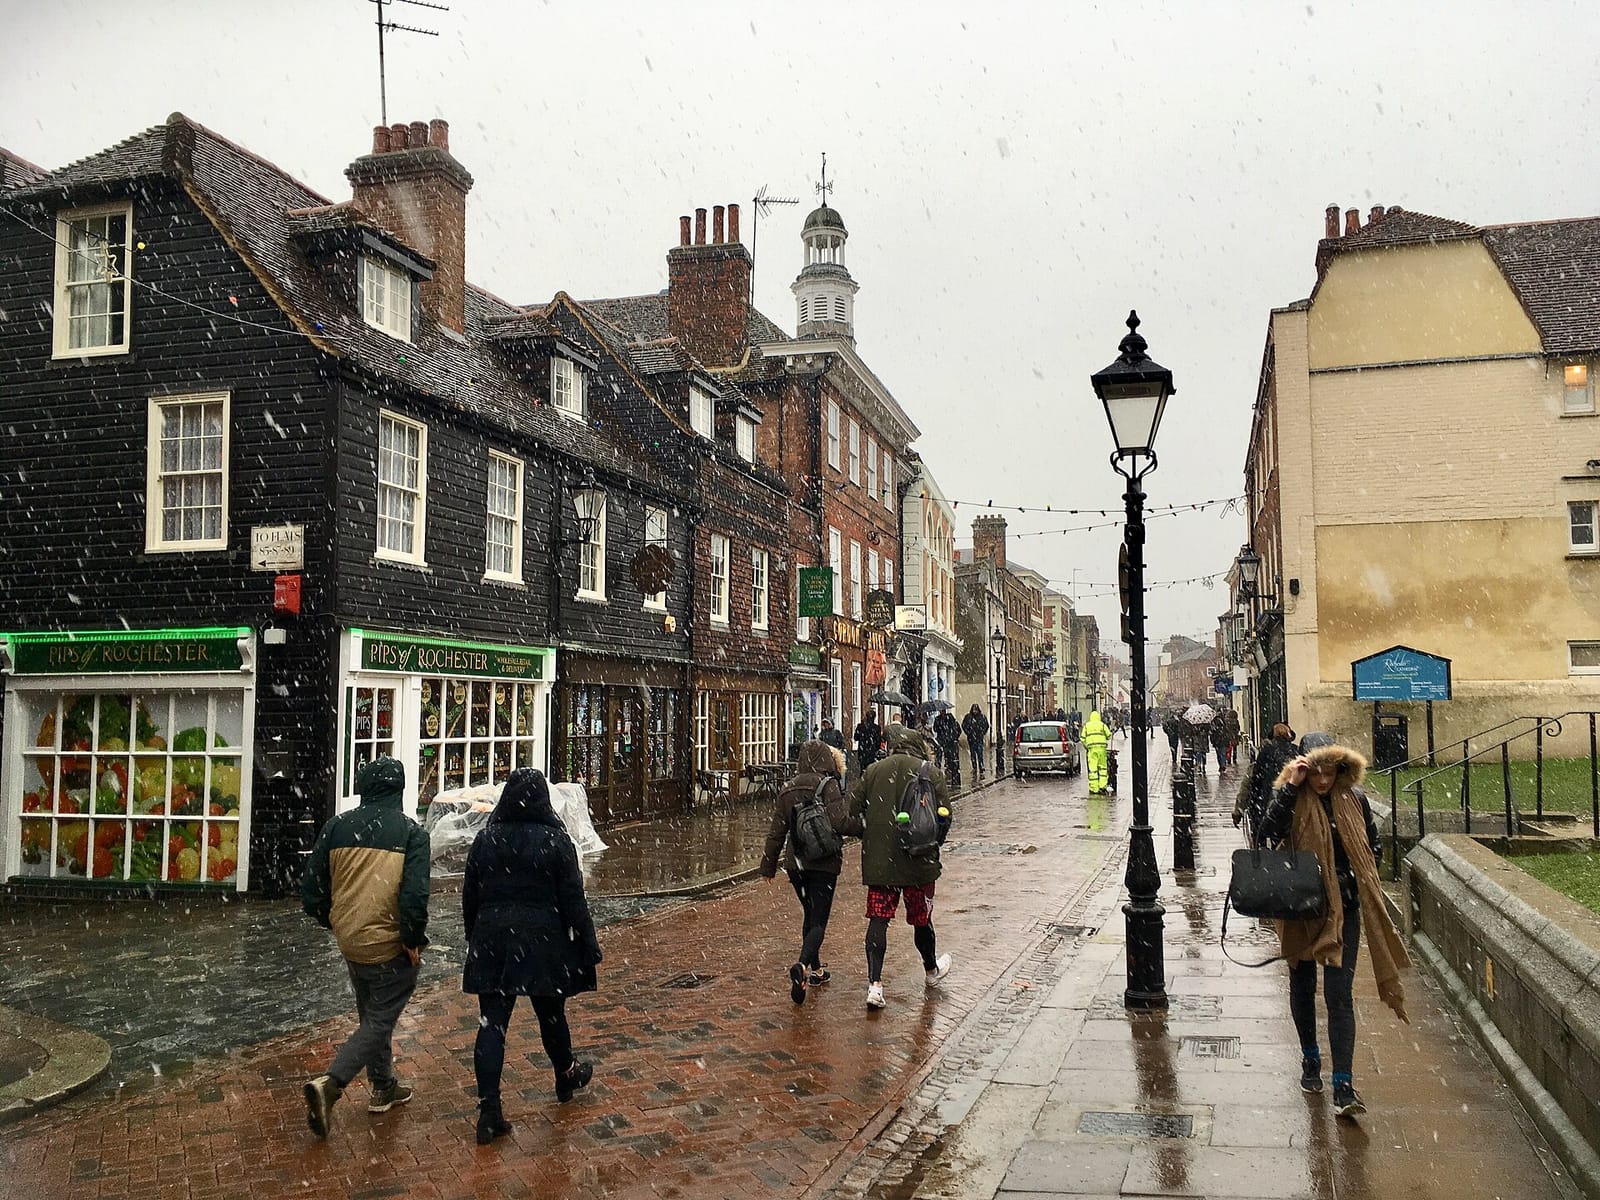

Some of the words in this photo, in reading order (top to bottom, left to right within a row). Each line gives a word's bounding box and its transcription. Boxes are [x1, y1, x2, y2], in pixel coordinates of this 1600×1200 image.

[256, 532, 269, 543] TO
[271, 531, 301, 542] FLATS
[49, 645, 79, 664] PIPS
[77, 643, 98, 671] of
[102, 643, 209, 664] ROCHESTER
[370, 642, 397, 665] PIPS
[398, 645, 417, 670] of
[418, 647, 489, 671] ROCHESTER
[356, 716, 371, 730] PIPS
